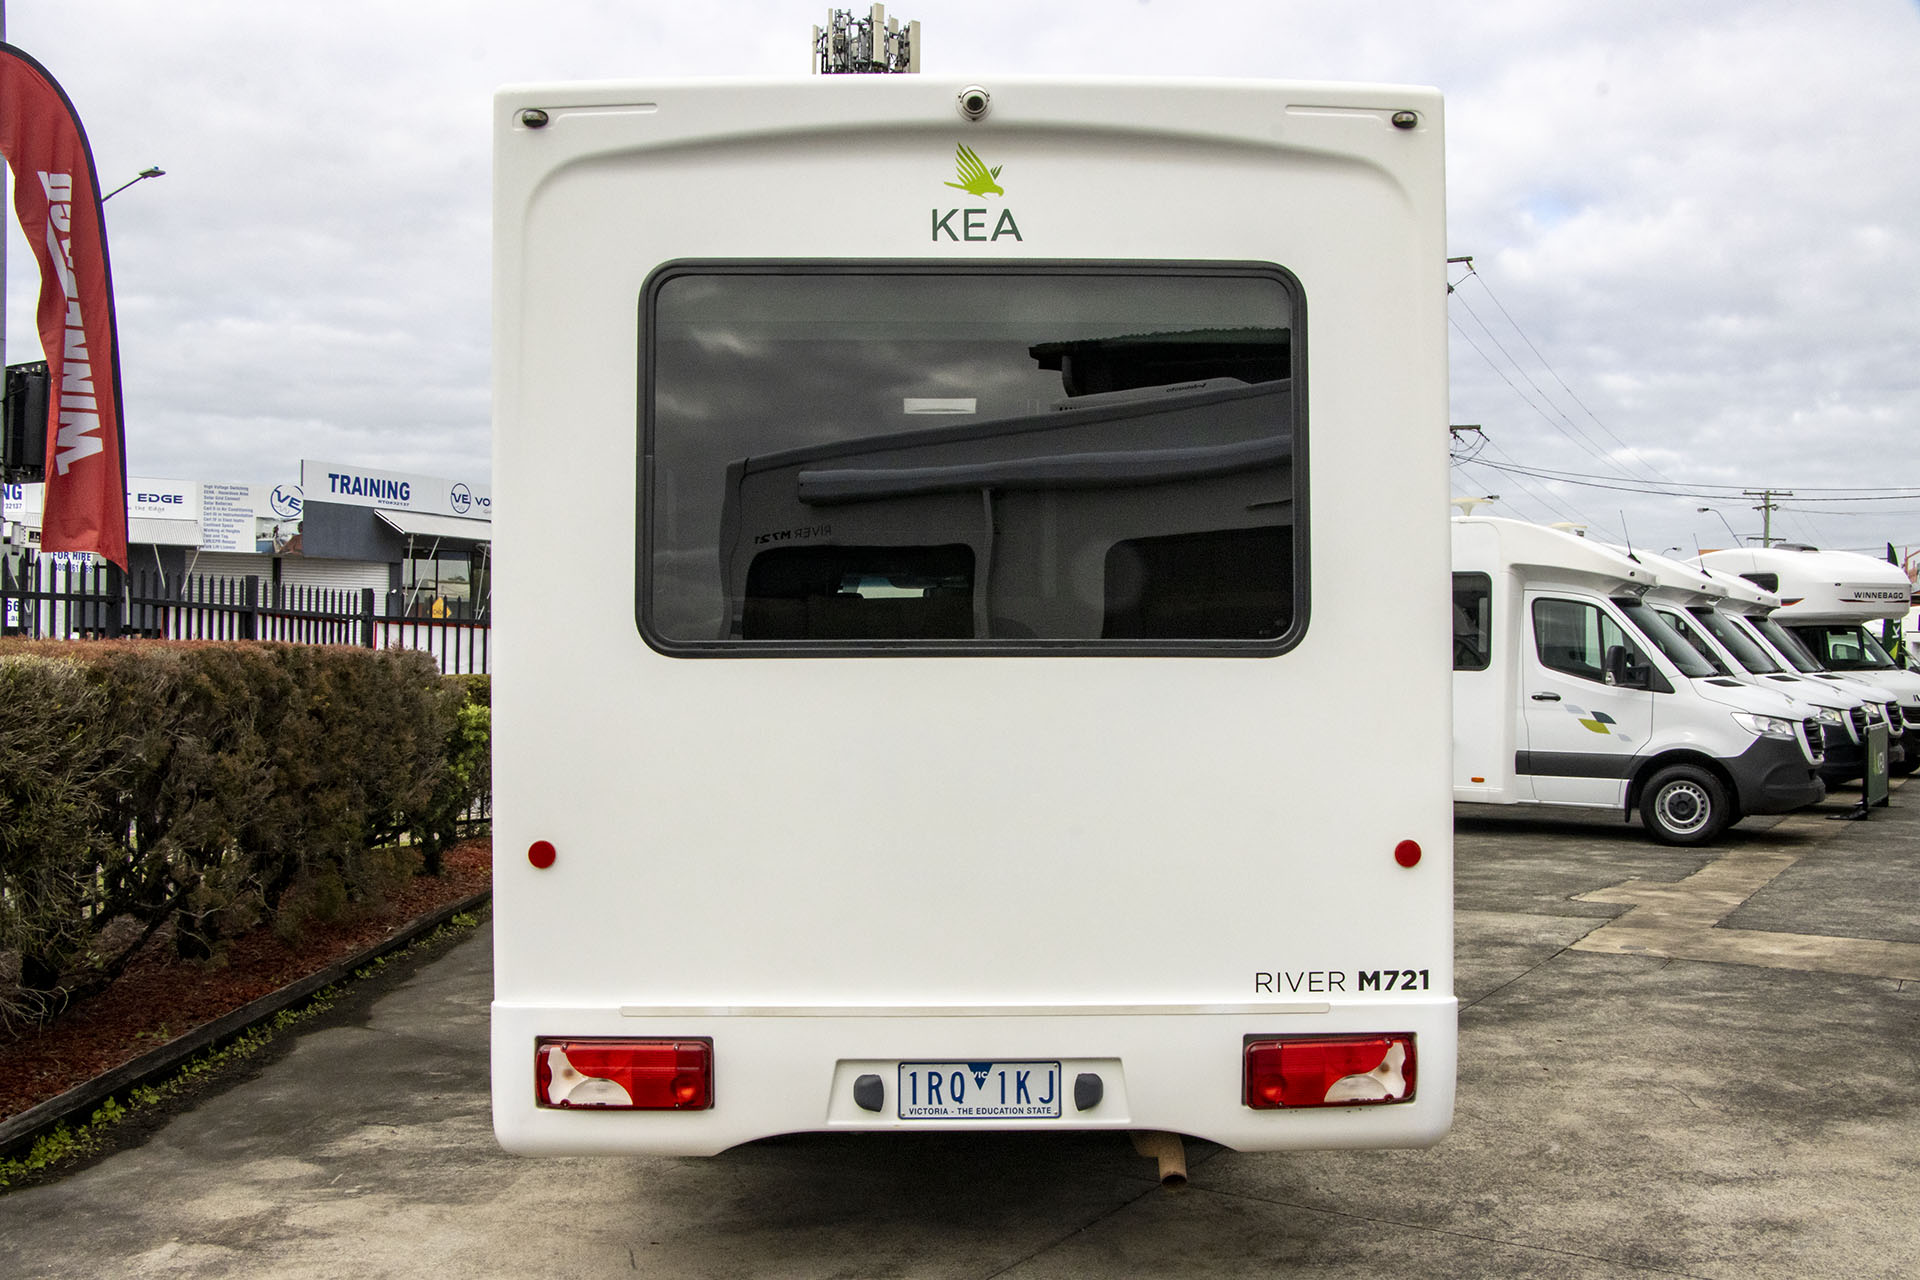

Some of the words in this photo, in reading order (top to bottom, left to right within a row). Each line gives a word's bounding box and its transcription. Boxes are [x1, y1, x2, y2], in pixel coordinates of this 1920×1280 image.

[932, 209, 1023, 241] KEA
[328, 473, 410, 501] TRAINING
[137, 493, 183, 504] EDGE
[451, 493, 471, 505] VE
[1854, 591, 1904, 600] WINNEBAGO
[1255, 971, 1346, 993] RIVER
[1358, 969, 1430, 991] M721
[973, 1071, 988, 1079] VIC
[909, 1071, 965, 1105] 1RQ
[998, 1070, 1054, 1104] 1KJ
[908, 1107, 949, 1115] VICTORIA
[957, 1107, 974, 1115] THE
[975, 1106, 1025, 1115] EDUCATION
[1026, 1106, 1052, 1115] STATE
